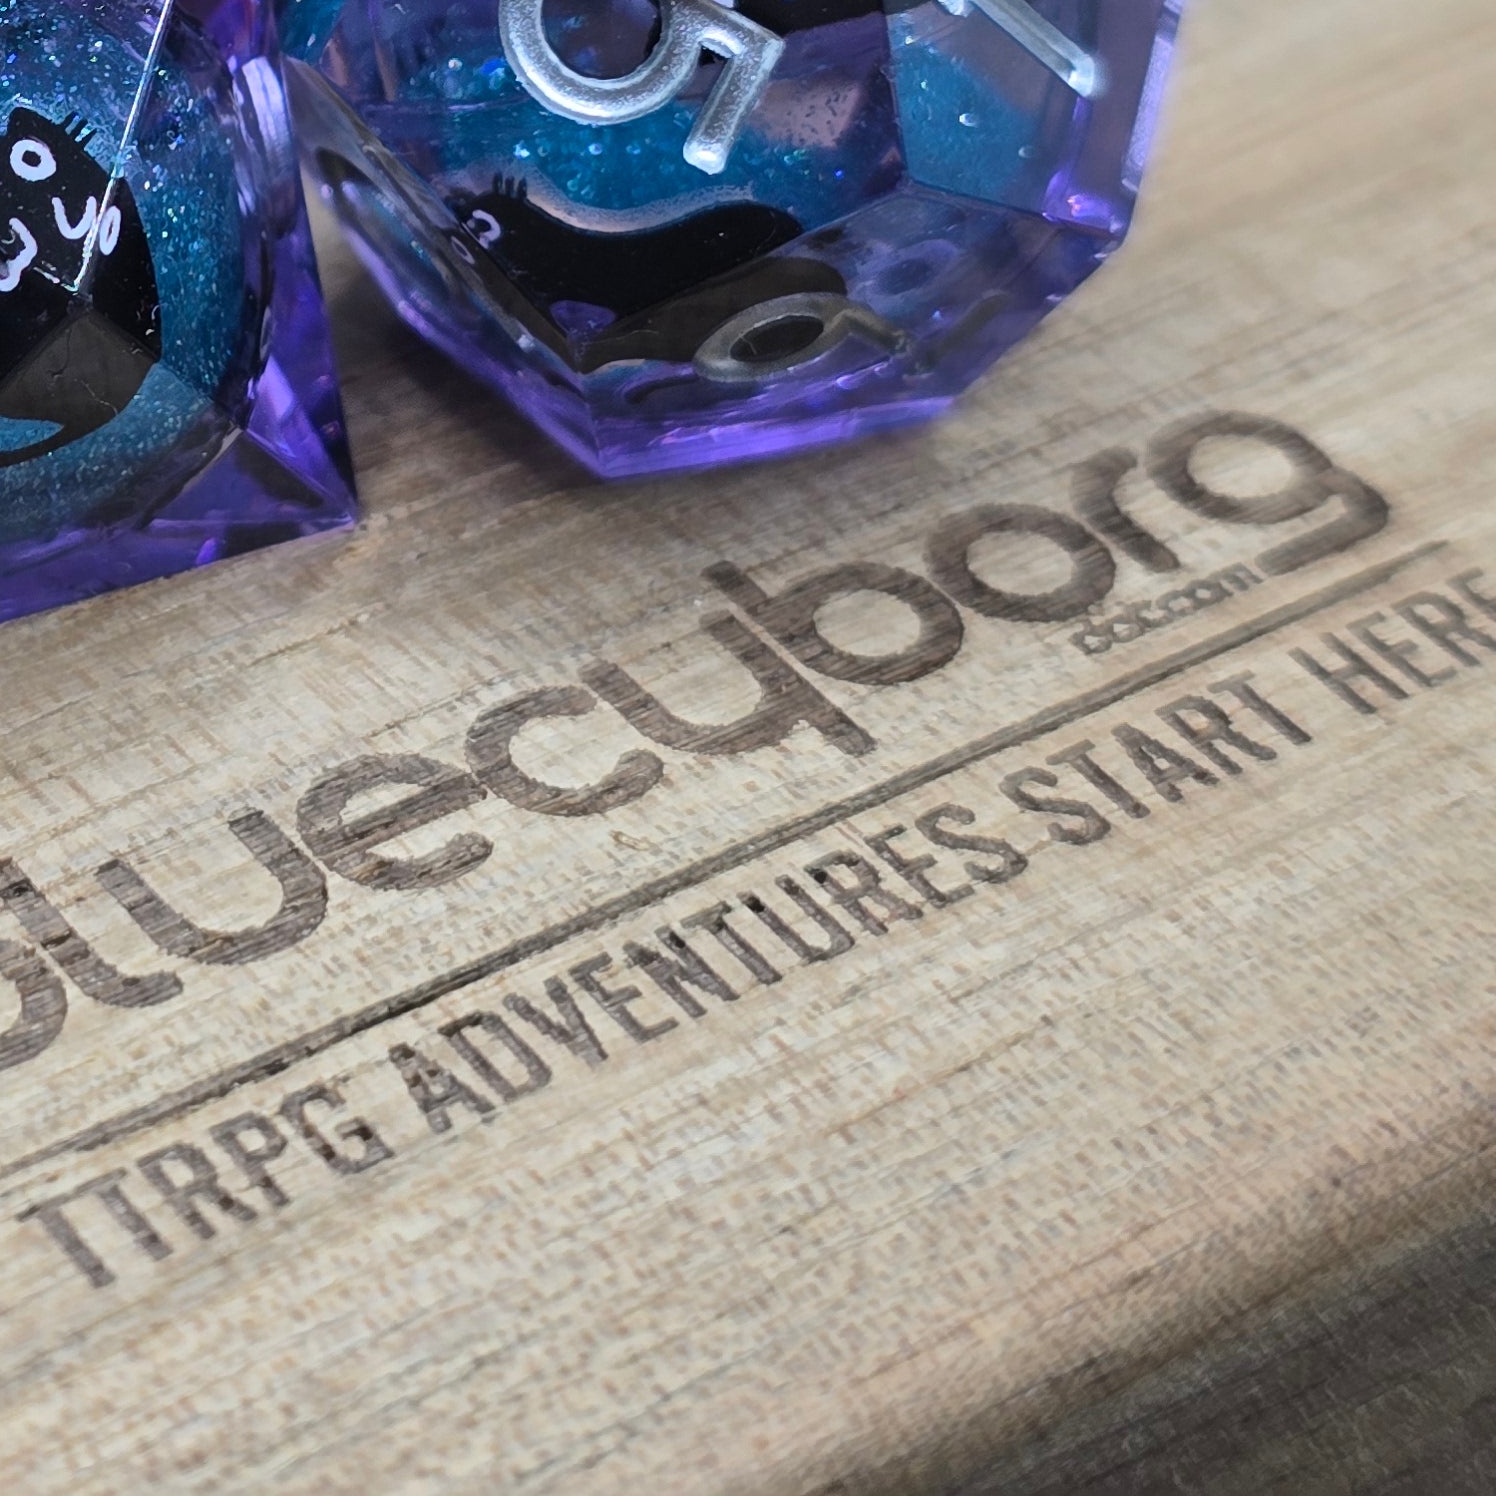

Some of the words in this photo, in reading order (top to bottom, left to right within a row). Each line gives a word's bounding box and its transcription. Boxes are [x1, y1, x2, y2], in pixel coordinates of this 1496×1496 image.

[14, 1082, 396, 1289] TTRPG
[387, 802, 1029, 1135] ADVENTURES
[998, 669, 1314, 846] START
